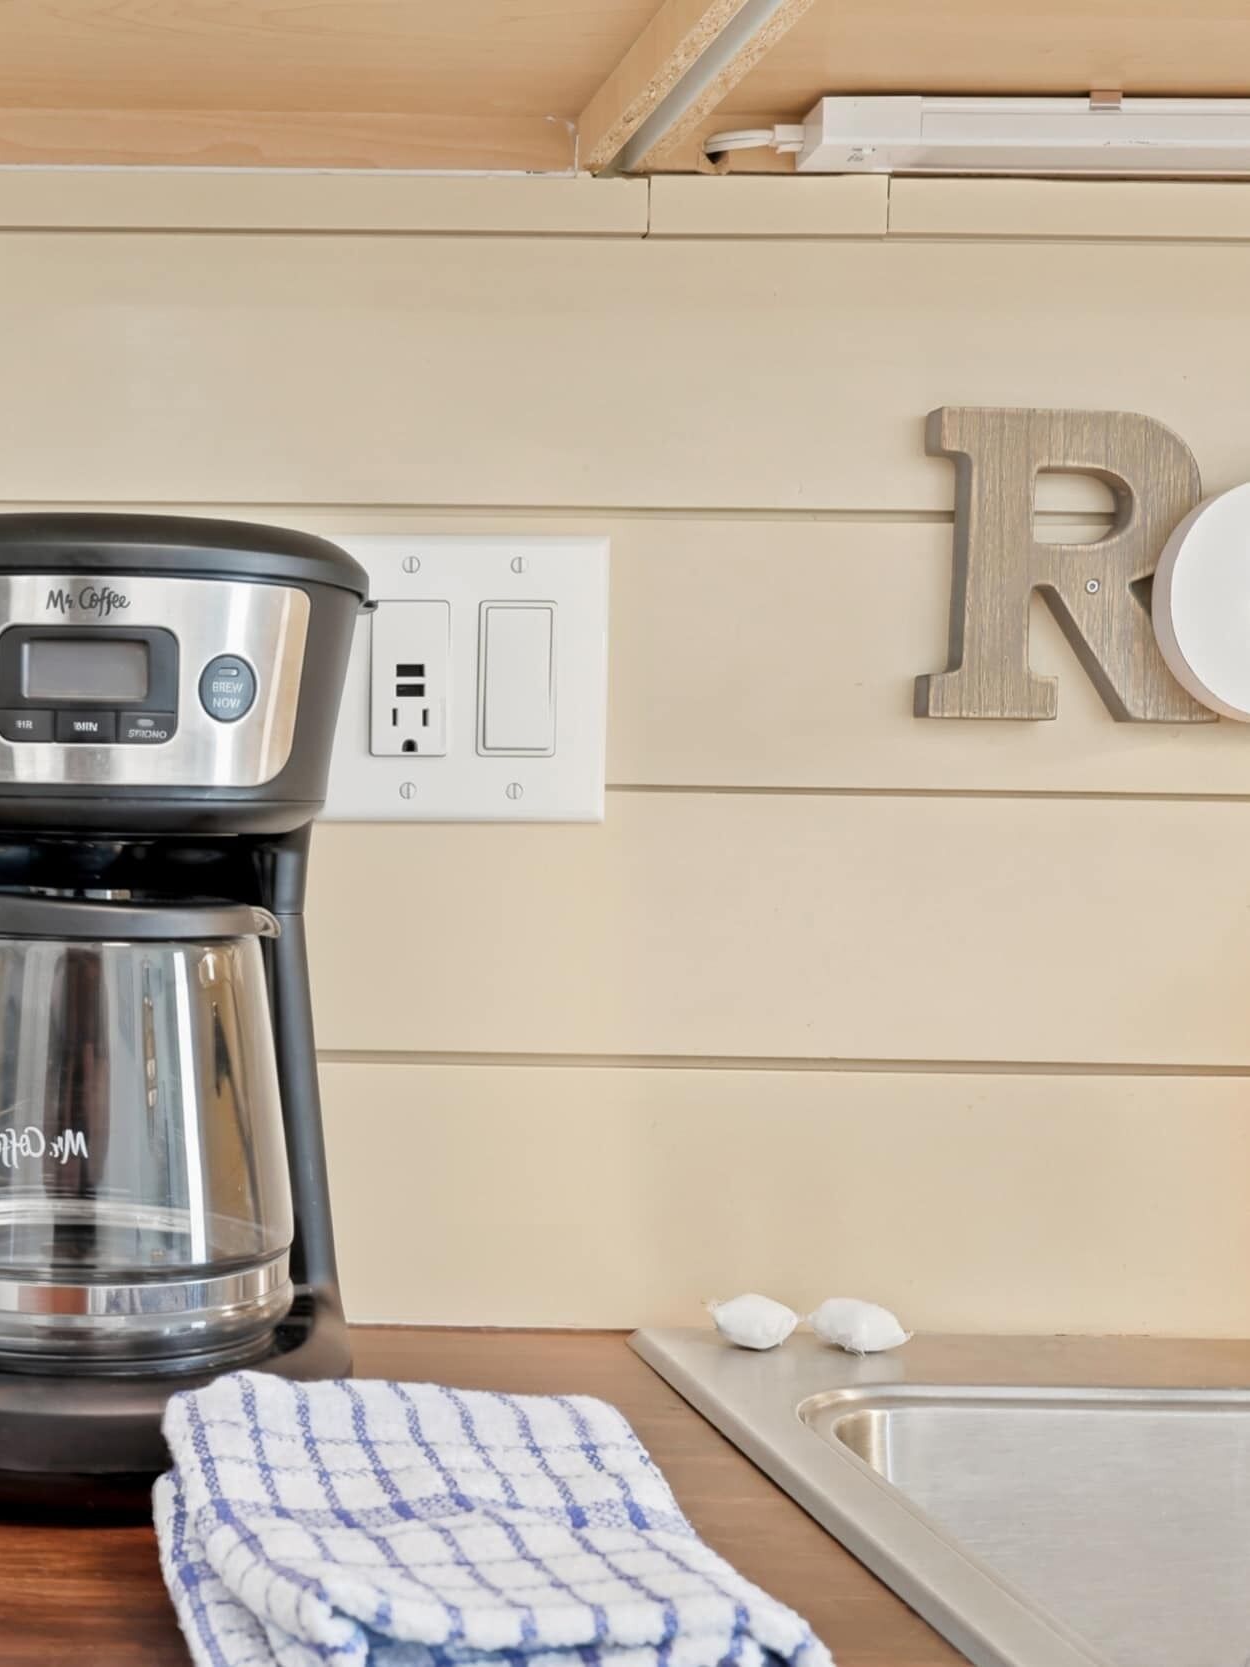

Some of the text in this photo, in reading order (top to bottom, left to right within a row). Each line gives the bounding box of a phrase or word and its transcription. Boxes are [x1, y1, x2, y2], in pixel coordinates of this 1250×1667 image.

[913, 406, 1220, 723] R
[79, 586, 131, 617] Coffee
[212, 681, 243, 693] BREW
[213, 697, 240, 709] NOW
